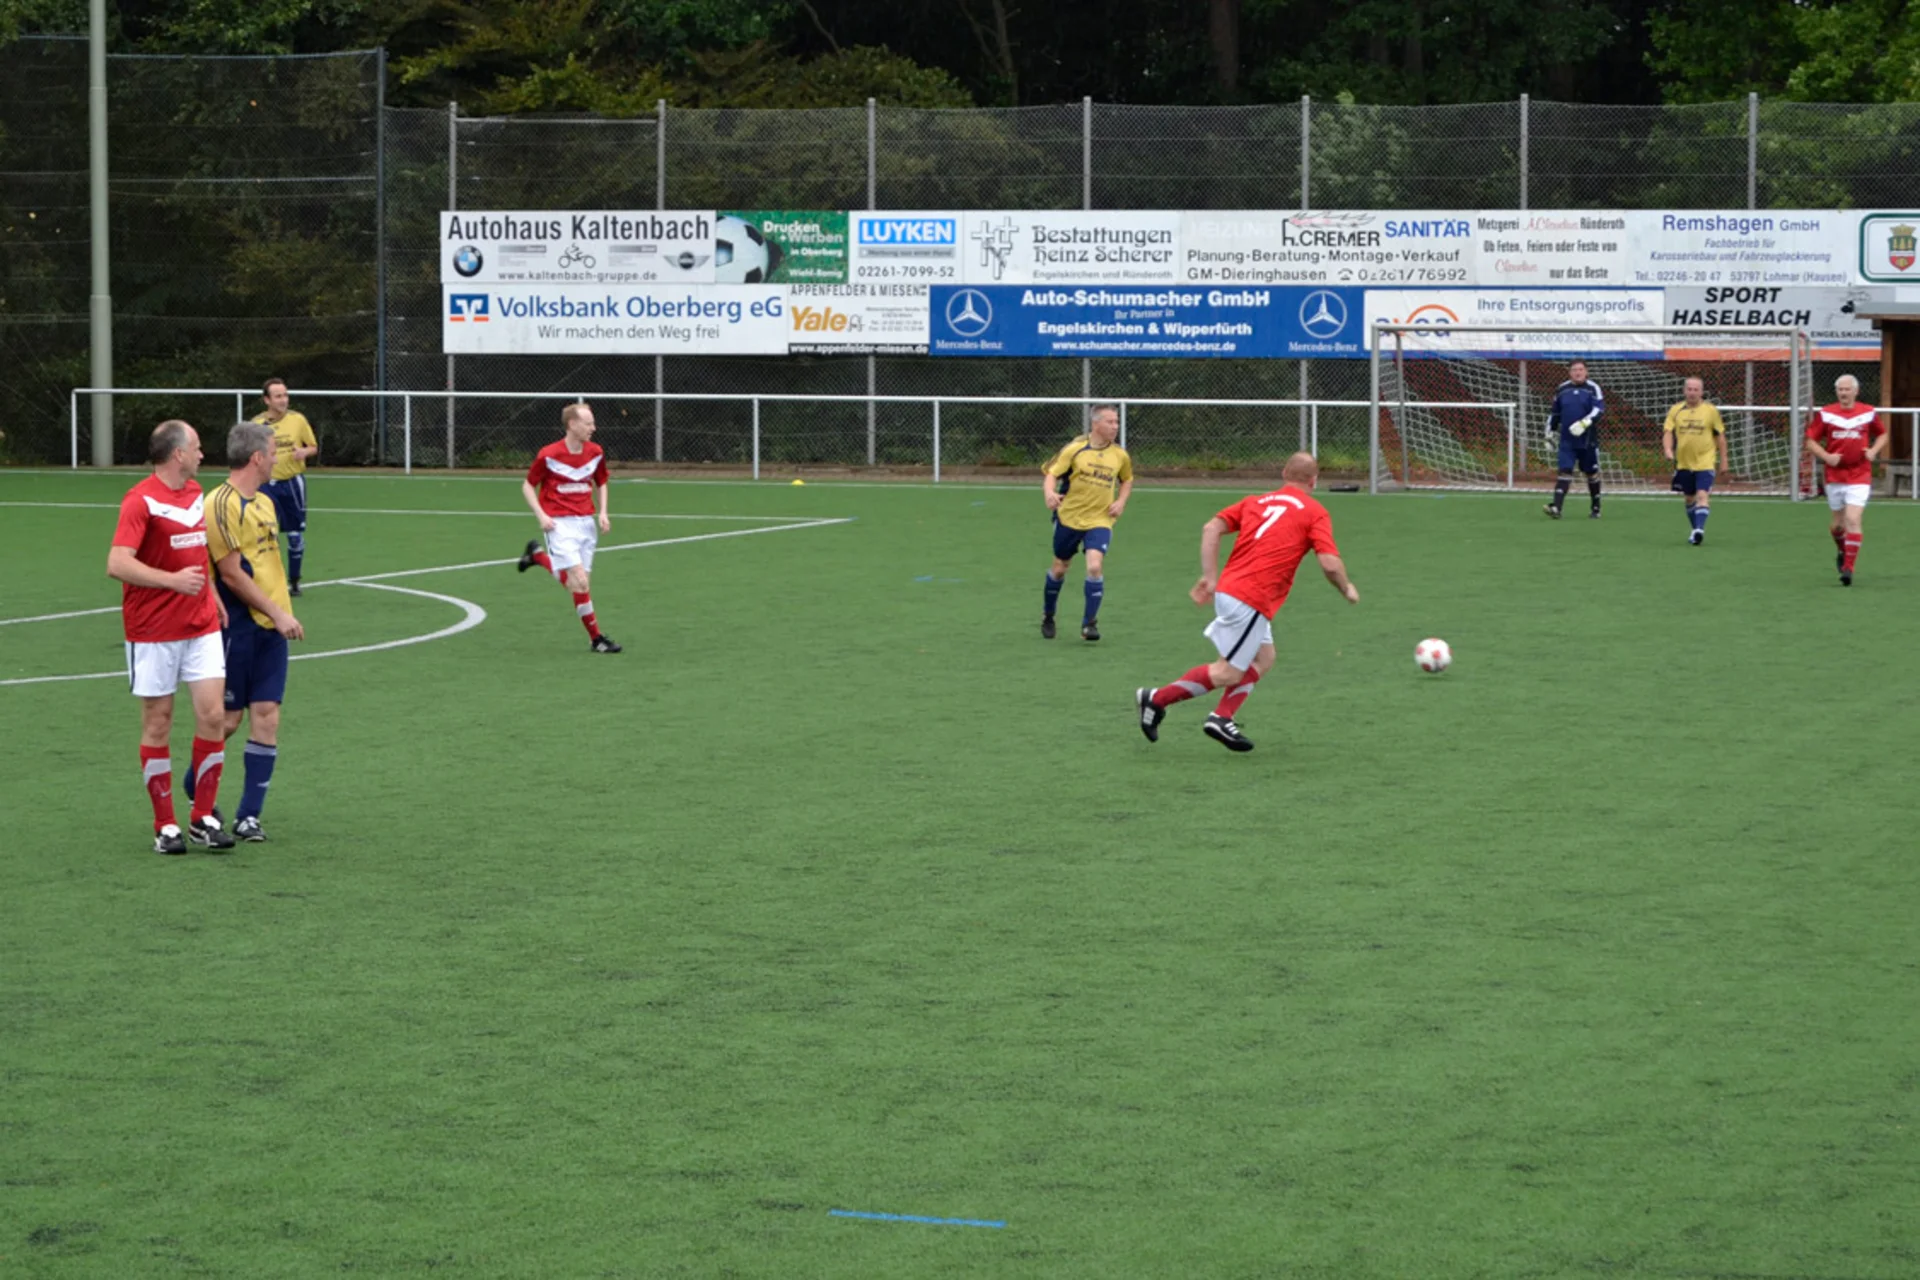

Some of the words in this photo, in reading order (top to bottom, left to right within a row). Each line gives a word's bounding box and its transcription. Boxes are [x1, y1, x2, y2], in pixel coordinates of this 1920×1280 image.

[448, 214, 562, 241] Autohaus
[571, 214, 710, 240] Kaltenbach
[763, 220, 820, 233] Drucken
[861, 221, 953, 242] LUYKEN
[1385, 219, 1470, 238] SANITÄR
[1478, 217, 1520, 232] Metzgerei
[1580, 217, 1625, 230] Ründeroth
[1663, 214, 1773, 235] Remshagen
[1780, 220, 1820, 231] GmbH
[1032, 225, 1172, 248] Bestattungen
[1704, 238, 1759, 249] Fachbetrieb
[1762, 238, 1776, 249] für
[1095, 246, 1173, 263] Scherer
[1650, 252, 1717, 262] Karosseriebau
[1720, 252, 1737, 262] und
[498, 270, 658, 283] www.kaltenbach-gruppe.de
[858, 266, 956, 278] 02261-7099-52
[1033, 270, 1100, 280] Engelskirchen
[1102, 270, 1120, 279] und
[1187, 268, 1327, 283] GM-Dieringhausen
[1763, 271, 1800, 282] Lohmar
[790, 284, 870, 297] APPENFELDER
[870, 285, 877, 296] &
[880, 284, 919, 297] MIESEN
[1021, 290, 1202, 307] Auto-Schumacher
[1208, 290, 1270, 307] GmbH
[1704, 287, 1783, 303] SPORT
[497, 295, 619, 317] Volksbank
[626, 296, 742, 323] Oberberg
[750, 297, 783, 318] eG
[1477, 298, 1505, 311] Ihre
[1510, 298, 1645, 313] Entsorgungsprofis
[791, 305, 848, 332] Yale
[1672, 309, 1812, 326] HASELBACH
[538, 325, 561, 339] Wir
[565, 325, 623, 339] machen
[627, 325, 655, 339] den
[659, 325, 691, 342] Weg
[695, 325, 720, 339] frei
[1038, 321, 1143, 336] Engelskirchen
[1148, 322, 1159, 335] &
[1164, 321, 1252, 337] Wipperfürth
[1052, 340, 1236, 352] www.schumacher.mercedes-benz.de
[1254, 505, 1288, 540] 7
